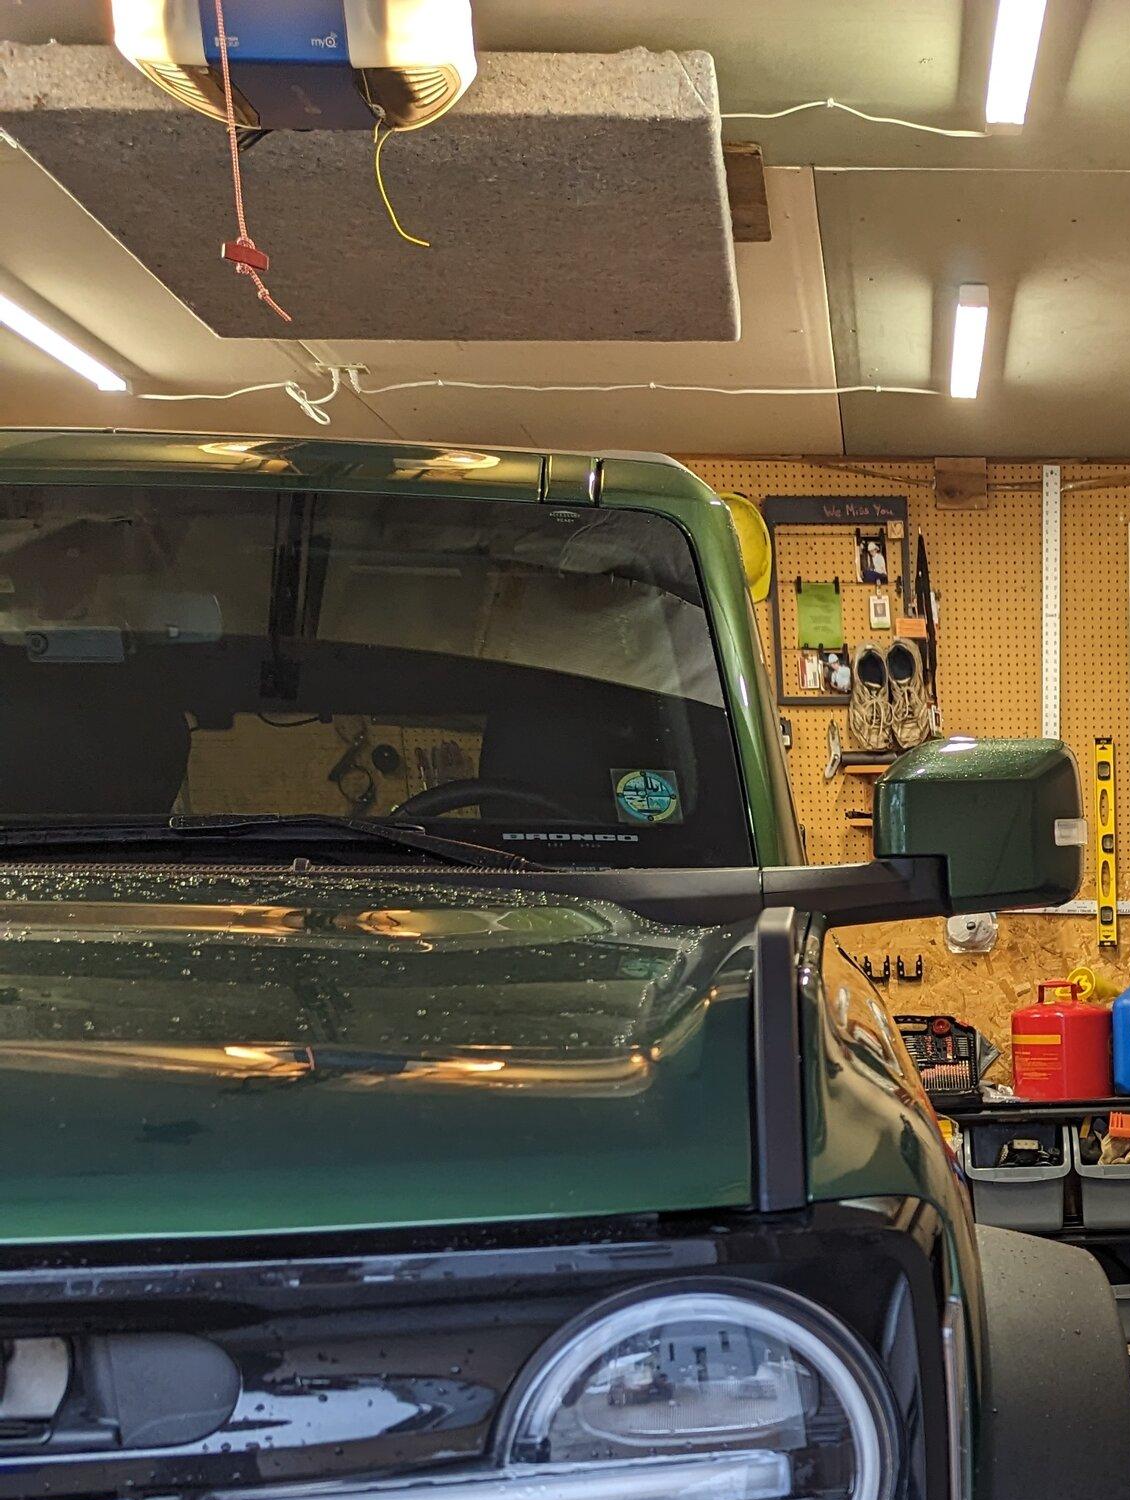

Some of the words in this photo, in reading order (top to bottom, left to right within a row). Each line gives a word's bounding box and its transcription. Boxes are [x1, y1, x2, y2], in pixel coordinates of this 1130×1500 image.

[311, 36, 336, 48] myQ
[823, 504, 841, 517] We
[845, 504, 870, 517] Miss
[873, 503, 894, 517] You
[502, 833, 639, 842] BRONCO
